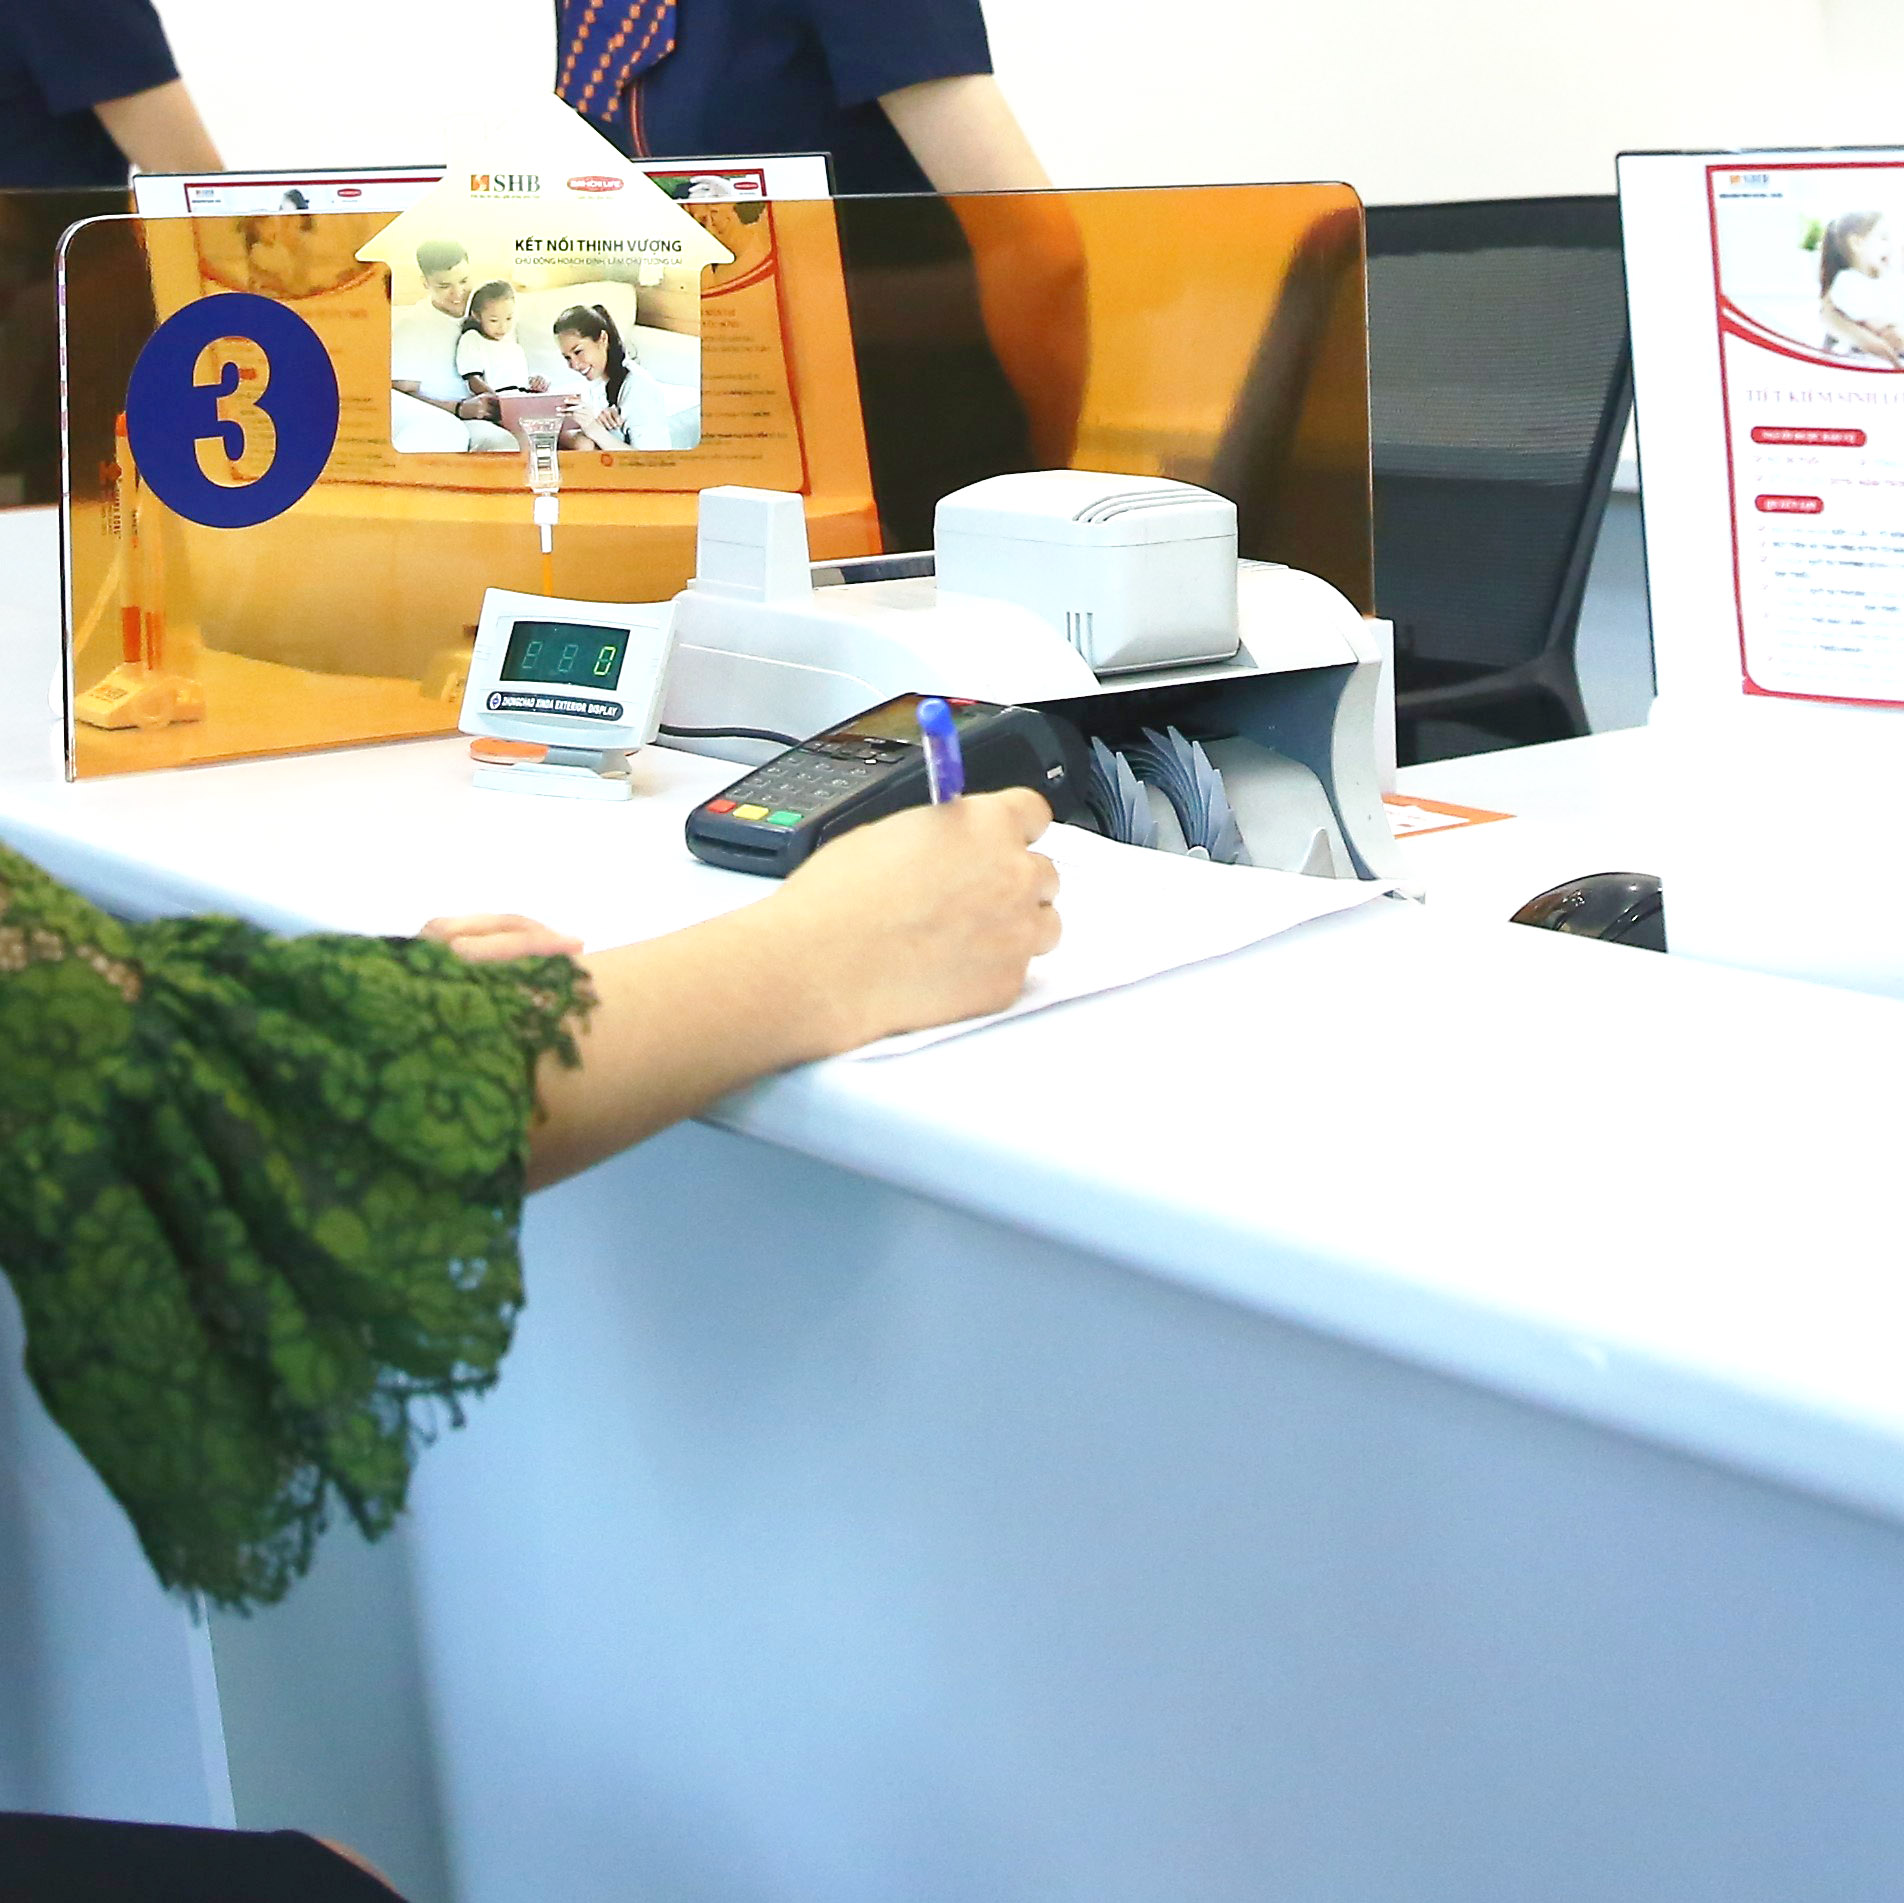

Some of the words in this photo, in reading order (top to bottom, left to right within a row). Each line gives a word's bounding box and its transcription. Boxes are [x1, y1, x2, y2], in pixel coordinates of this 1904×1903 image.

[494, 174, 540, 193] SHB
[515, 235, 543, 252] KẾT
[546, 235, 574, 252] NỐI
[577, 238, 623, 255] THỊNH
[627, 238, 682, 255] VƯỢNG
[191, 336, 277, 489] 3
[555, 699, 586, 712] EXTERIOR
[588, 703, 618, 717] DISPLAY
